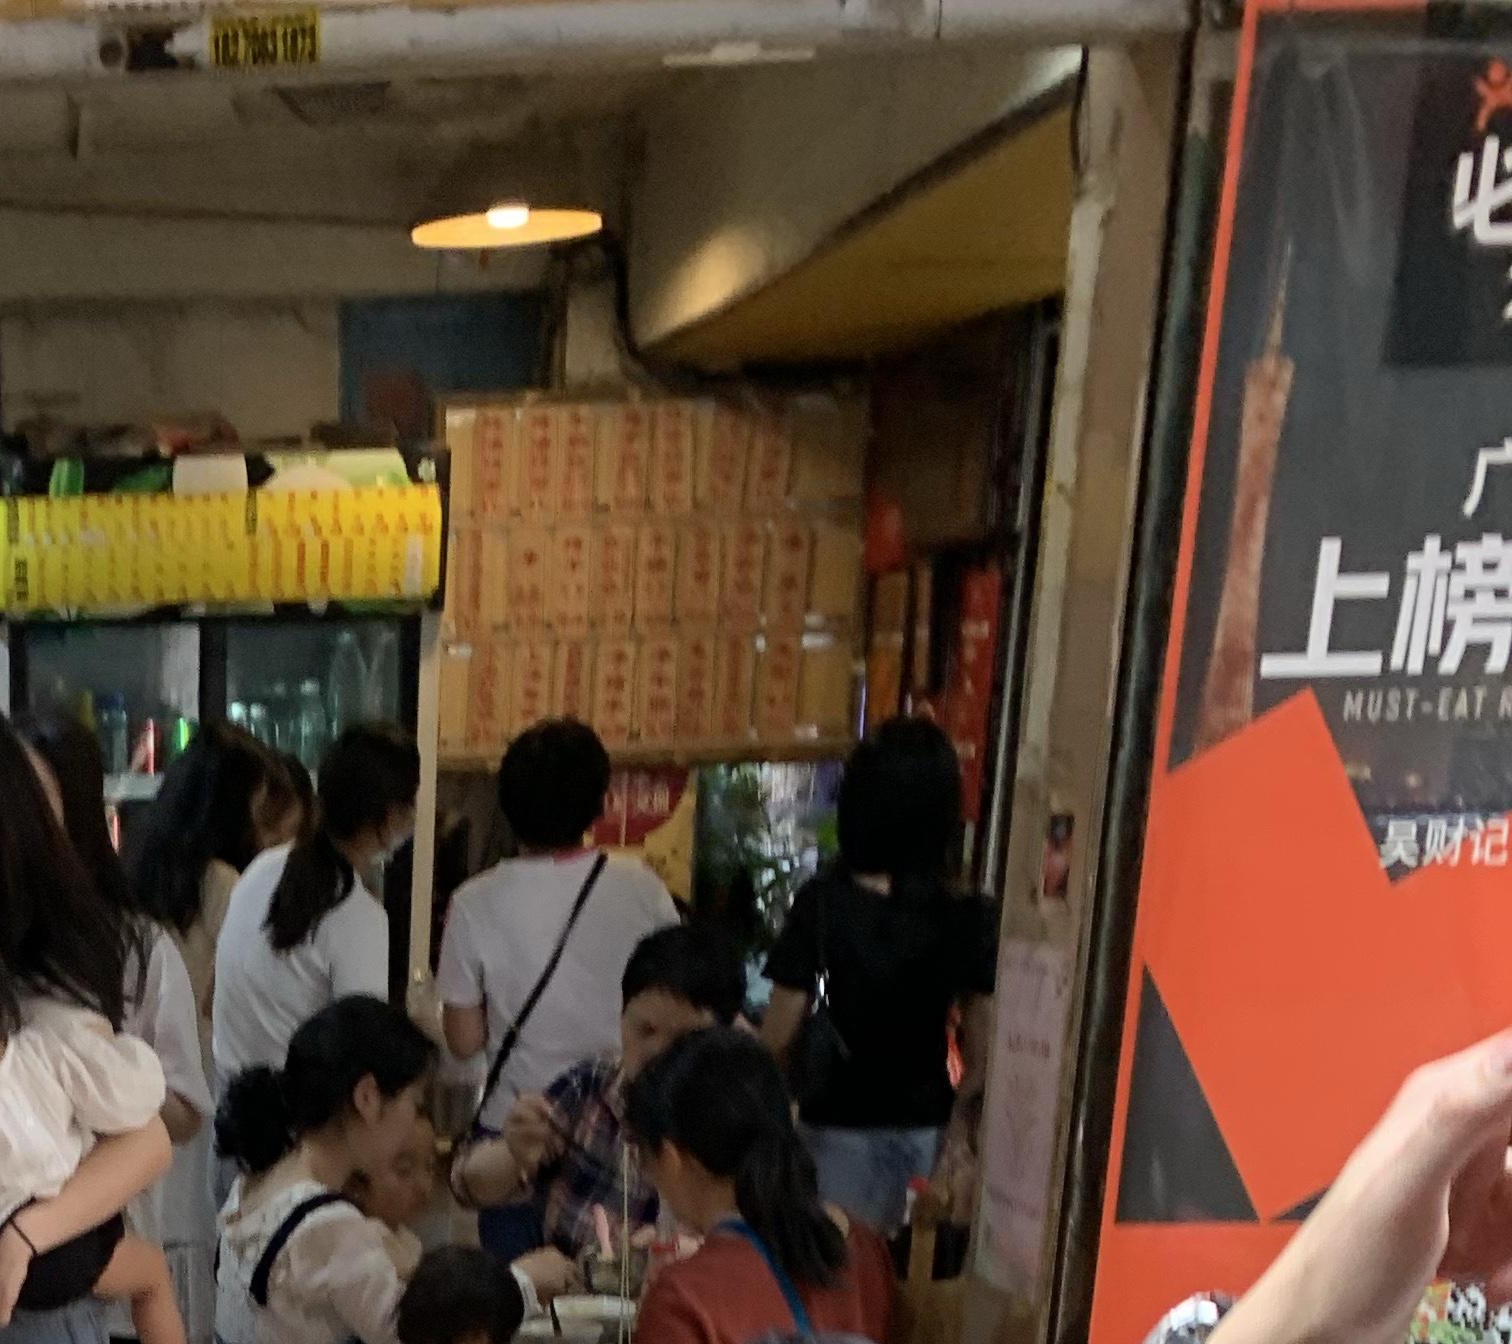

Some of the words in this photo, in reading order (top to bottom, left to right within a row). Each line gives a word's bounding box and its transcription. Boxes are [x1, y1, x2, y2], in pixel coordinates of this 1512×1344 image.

[1343, 686, 1487, 722] MUST-EAT
[1379, 816, 1510, 869] 吴财记
